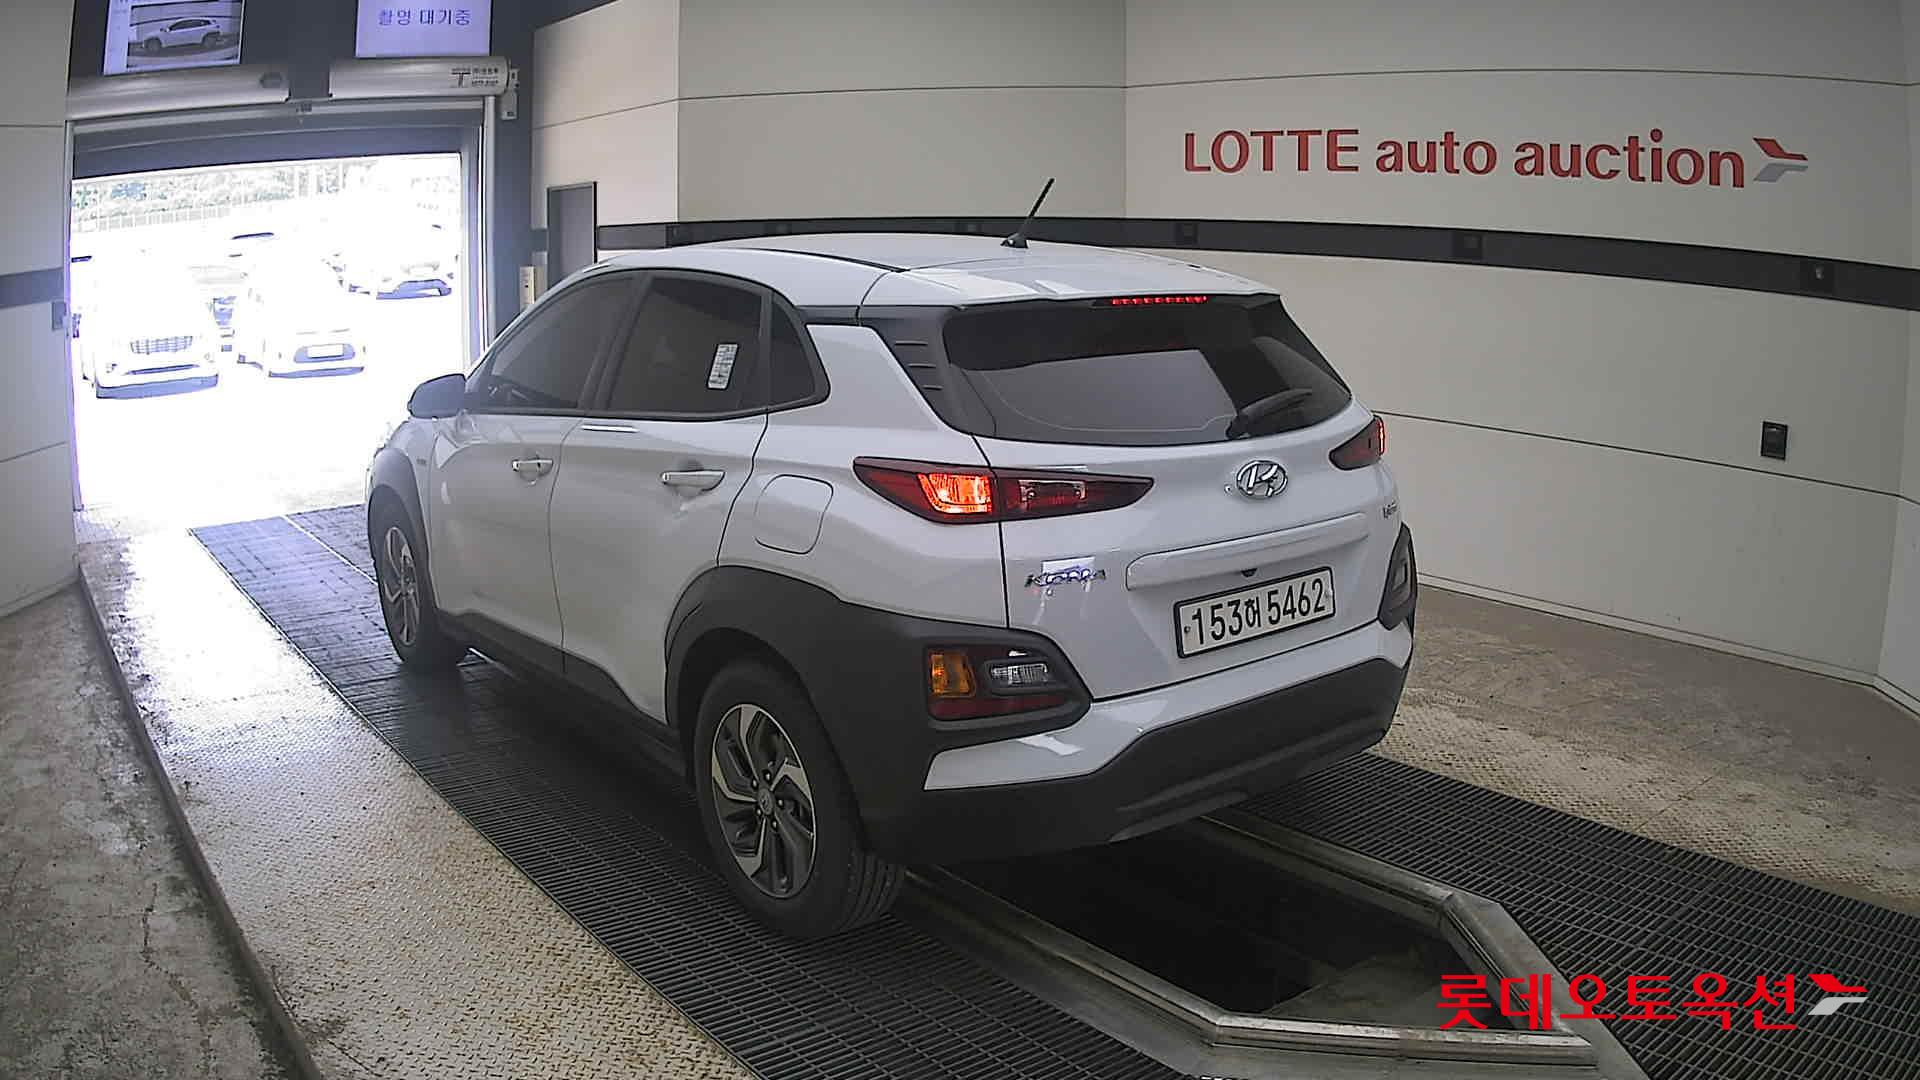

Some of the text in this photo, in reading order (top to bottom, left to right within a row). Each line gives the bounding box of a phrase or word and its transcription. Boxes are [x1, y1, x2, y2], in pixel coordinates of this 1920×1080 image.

[419, 9, 471, 26] 대기중
[1184, 128, 1745, 188] LOTTE auto auction
[1191, 577, 1327, 646] 153허 5462
